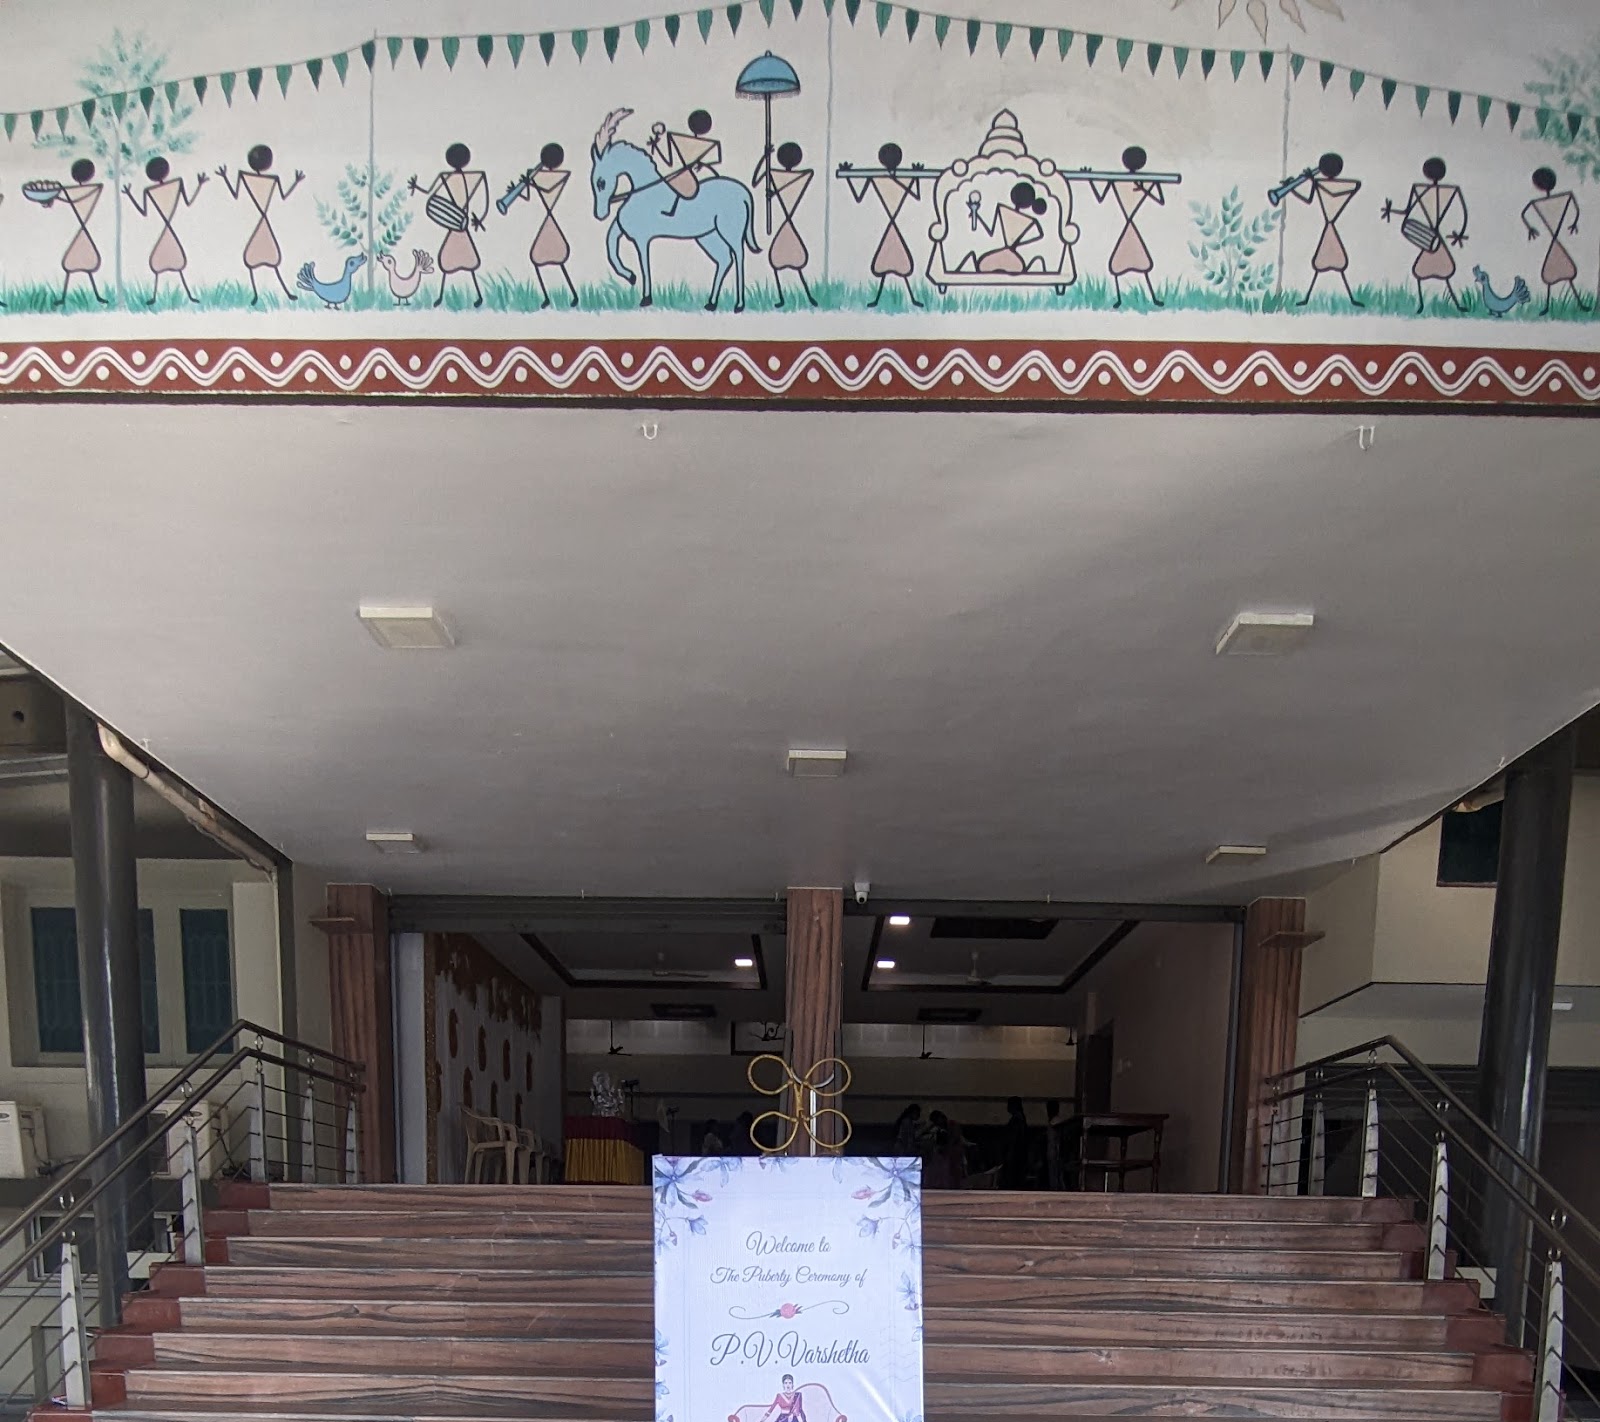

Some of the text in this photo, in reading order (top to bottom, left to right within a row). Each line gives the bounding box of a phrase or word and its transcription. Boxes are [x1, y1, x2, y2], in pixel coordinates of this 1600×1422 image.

[746, 1230, 831, 1256] Welcome to
[710, 1265, 868, 1288] The Puberty Ceremony of
